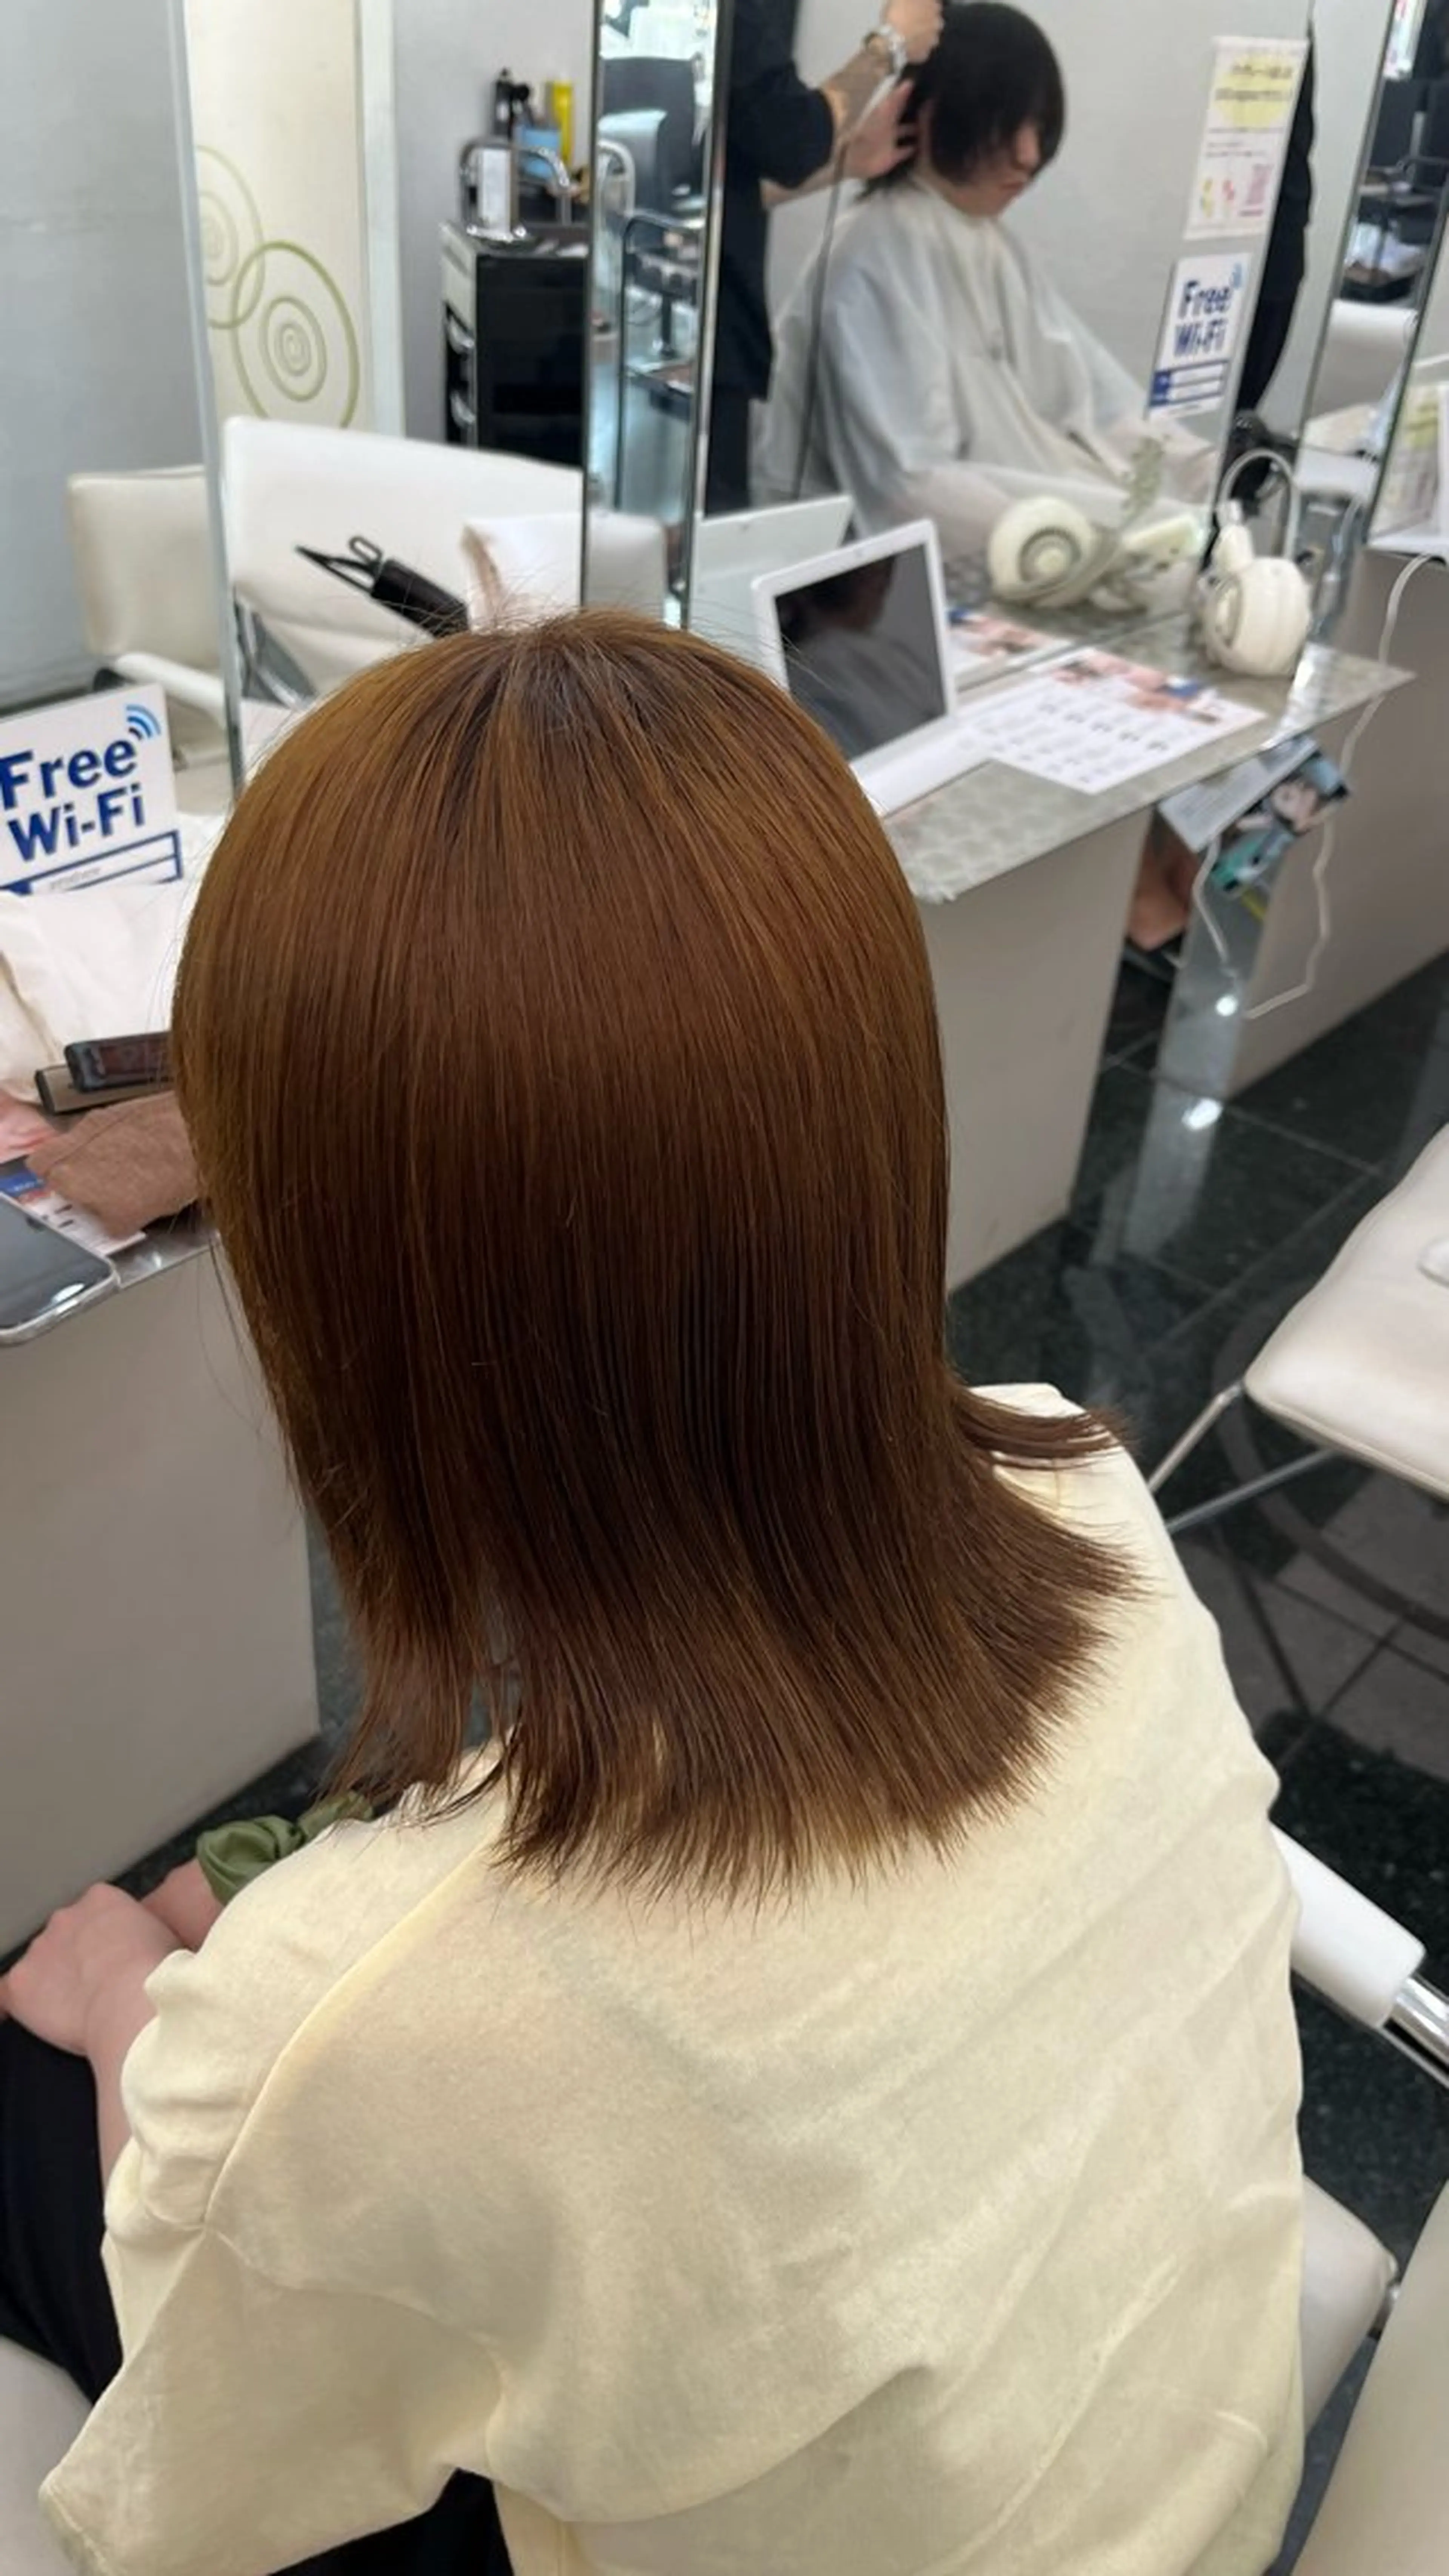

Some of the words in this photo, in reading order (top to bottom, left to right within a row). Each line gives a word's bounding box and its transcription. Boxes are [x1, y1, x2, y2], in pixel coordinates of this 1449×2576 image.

[1179, 280, 1231, 318] Free
[0, 740, 137, 809] Free
[8, 783, 145, 861] Wi-Fi
